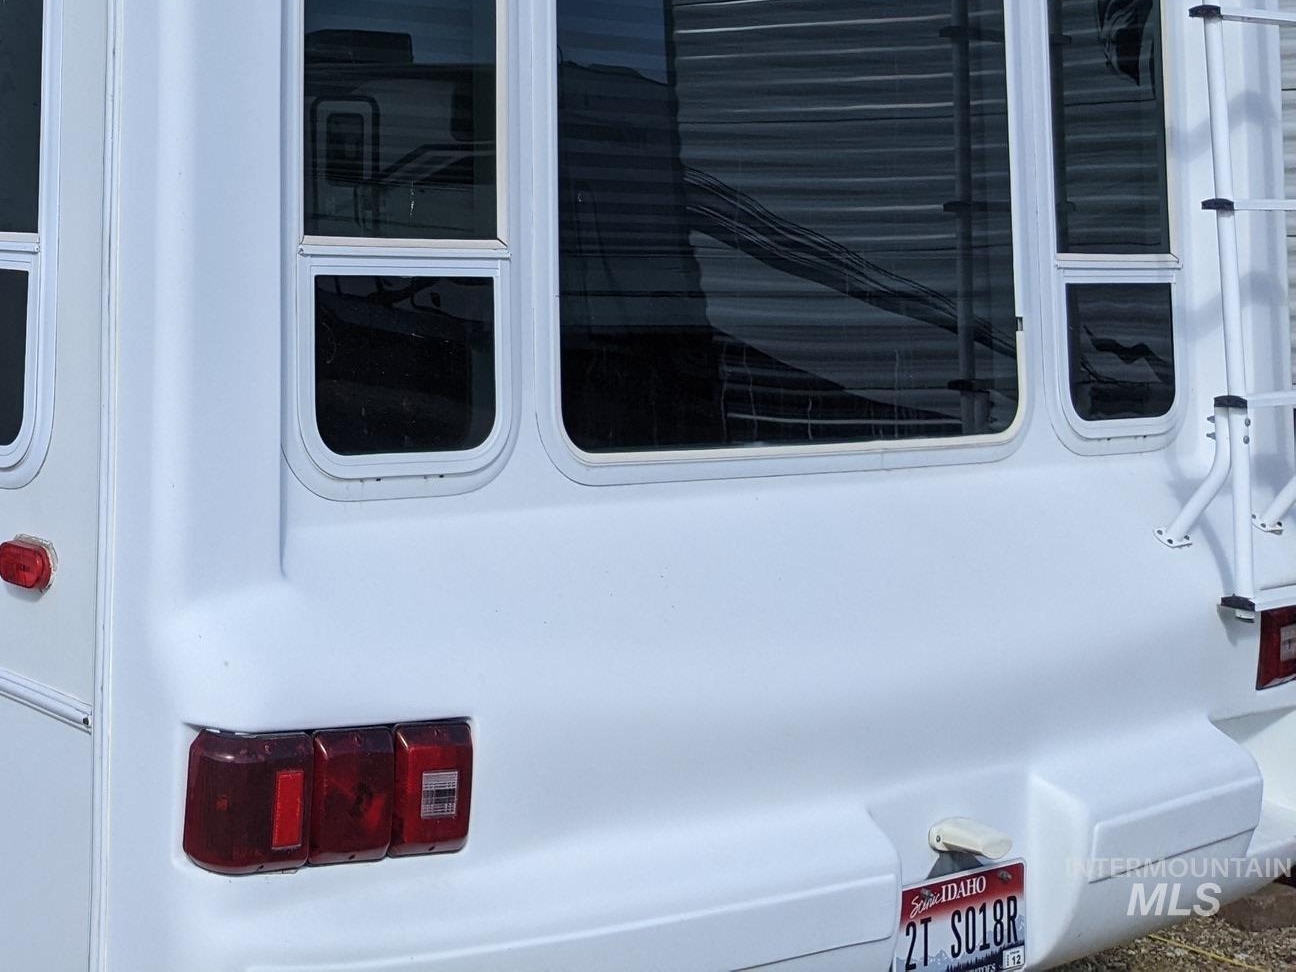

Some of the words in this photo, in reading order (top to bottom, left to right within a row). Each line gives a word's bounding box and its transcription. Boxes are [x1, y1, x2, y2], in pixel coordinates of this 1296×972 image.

[941, 875, 987, 903] IDAHO
[905, 916, 932, 971] 2T
[950, 895, 1018, 959] S018R
[1011, 954, 1021, 966] 12
